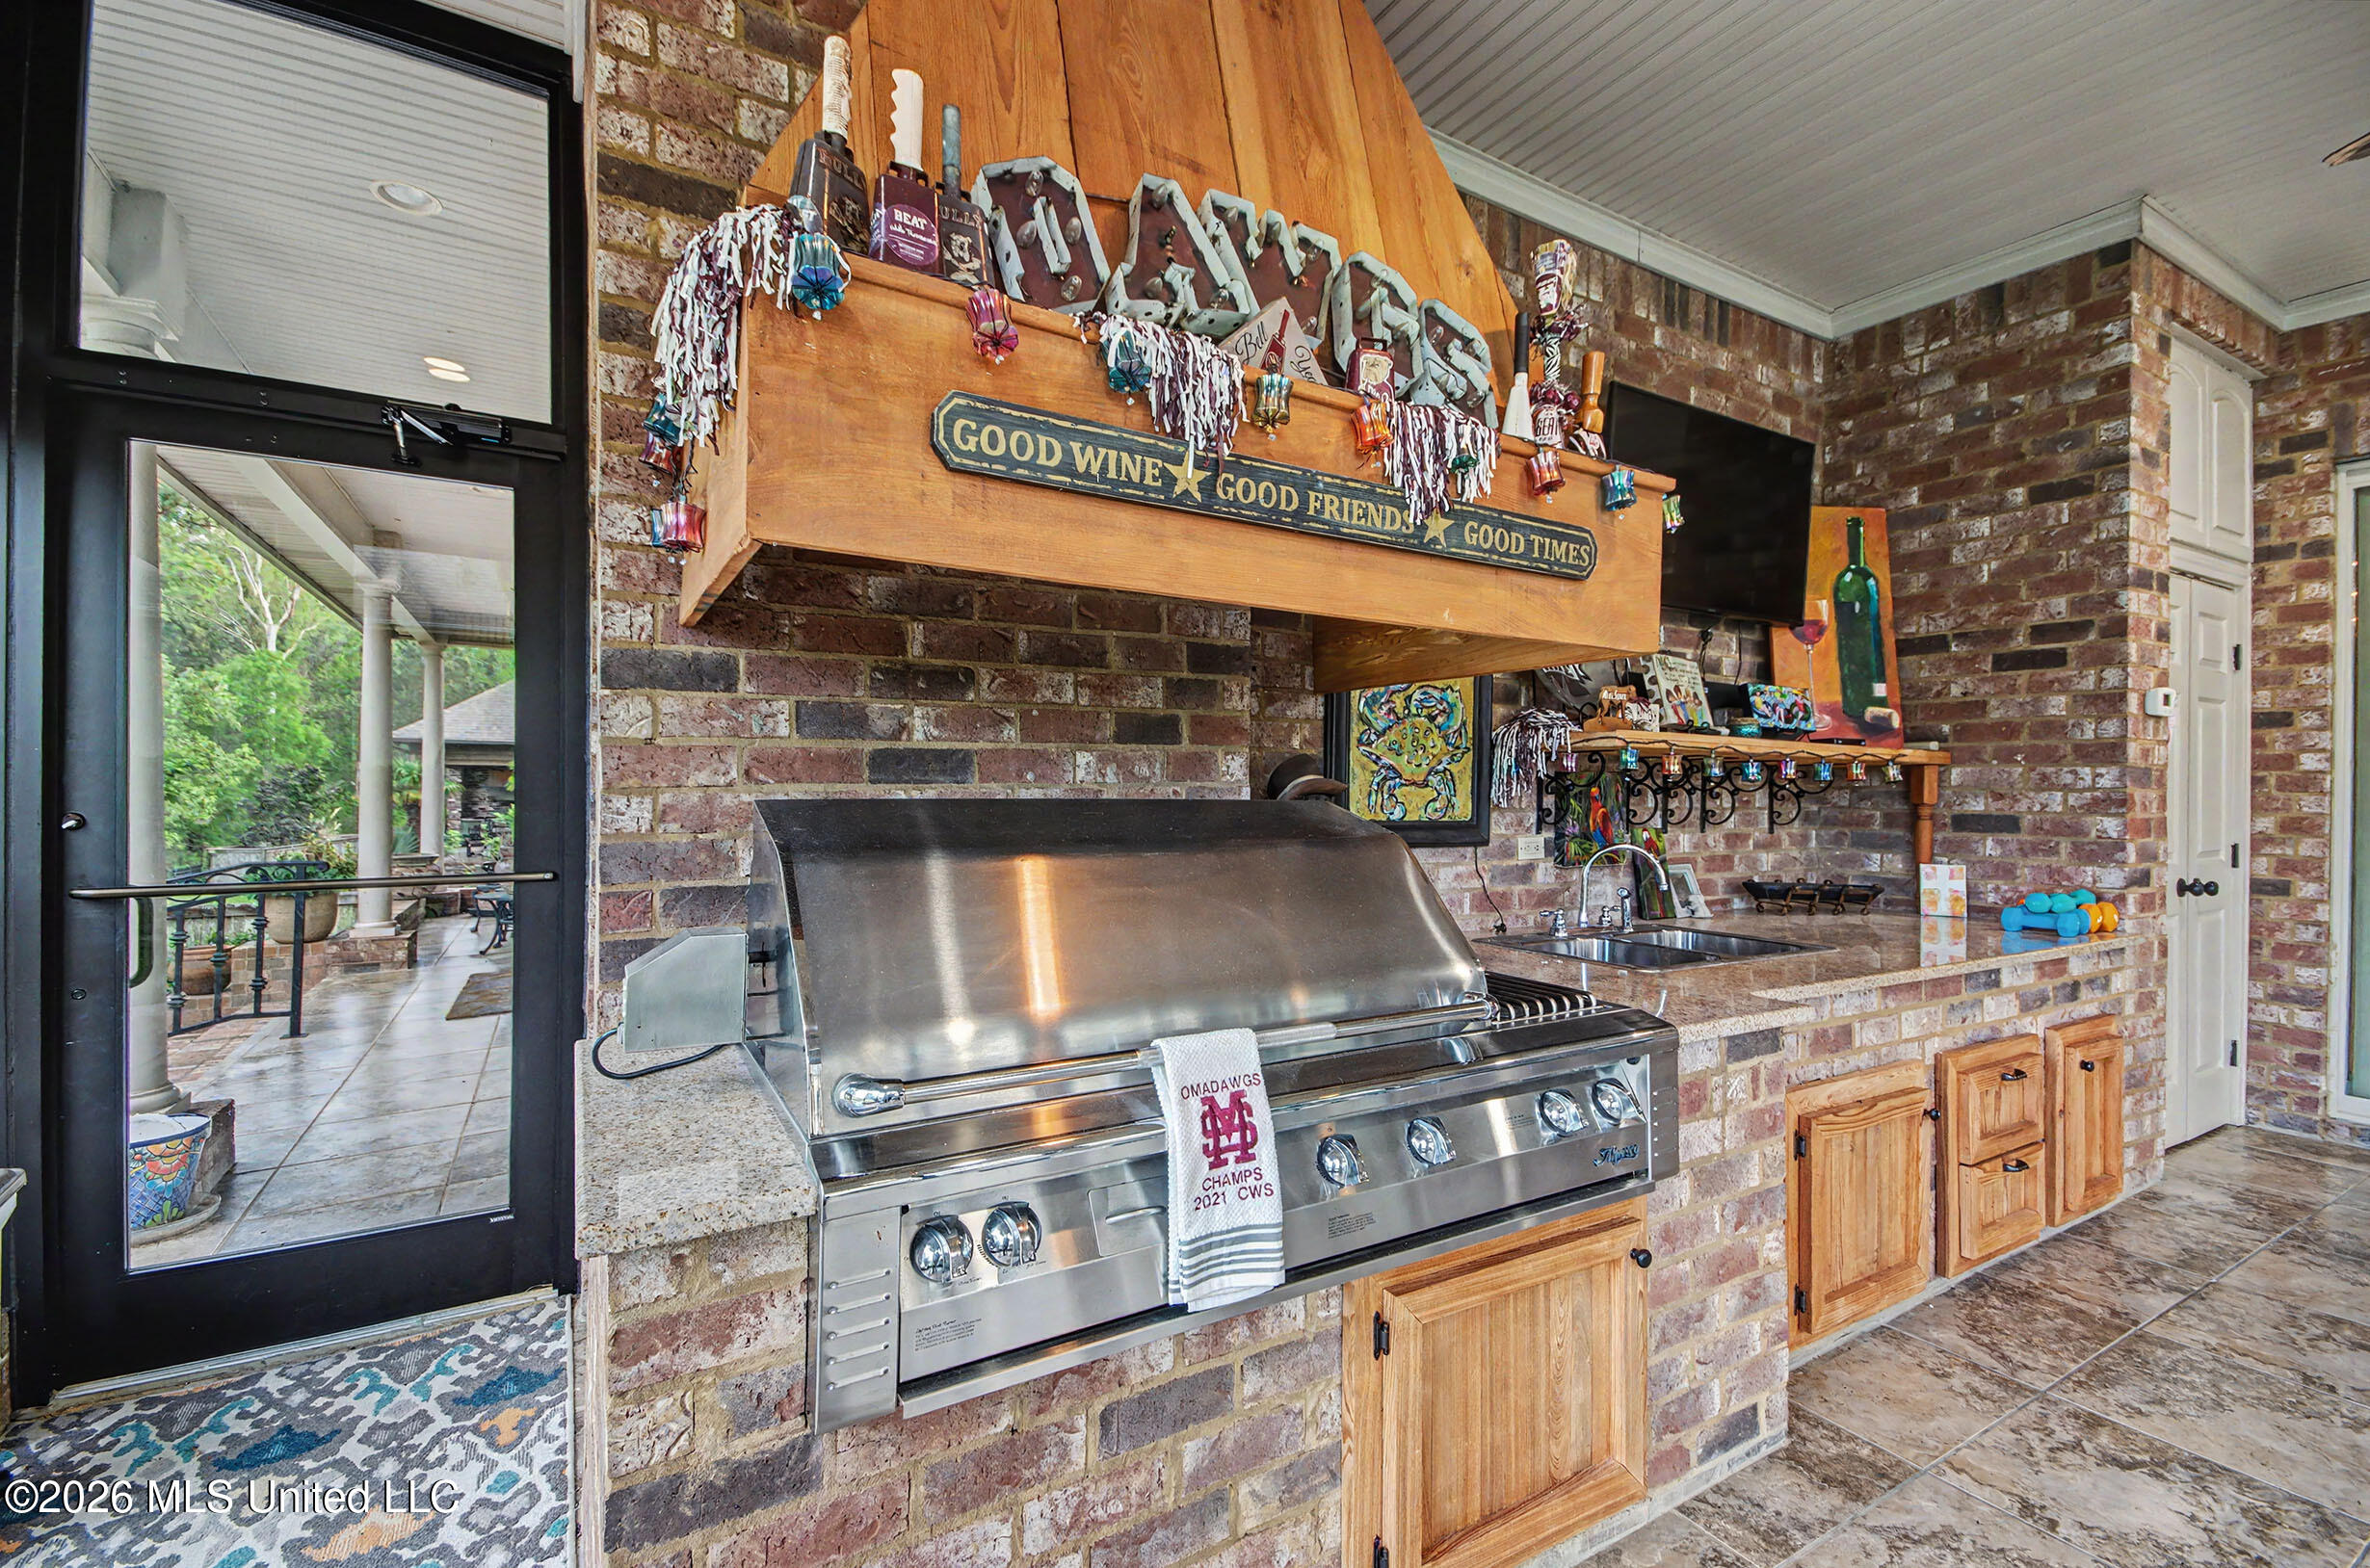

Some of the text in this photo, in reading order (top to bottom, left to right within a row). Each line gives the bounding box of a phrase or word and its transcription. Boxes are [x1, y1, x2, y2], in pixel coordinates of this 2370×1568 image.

[893, 208, 928, 231] BEAT
[1234, 321, 1269, 364] Bell
[952, 417, 1592, 567] GOOD WINE GOOD FRIENDS GOOD TIMES
[1181, 1073, 1261, 1100] OMADAWGS
[1202, 1167, 1263, 1191] CHAMPS
[1194, 1182, 1275, 1211] 2021 CWS
